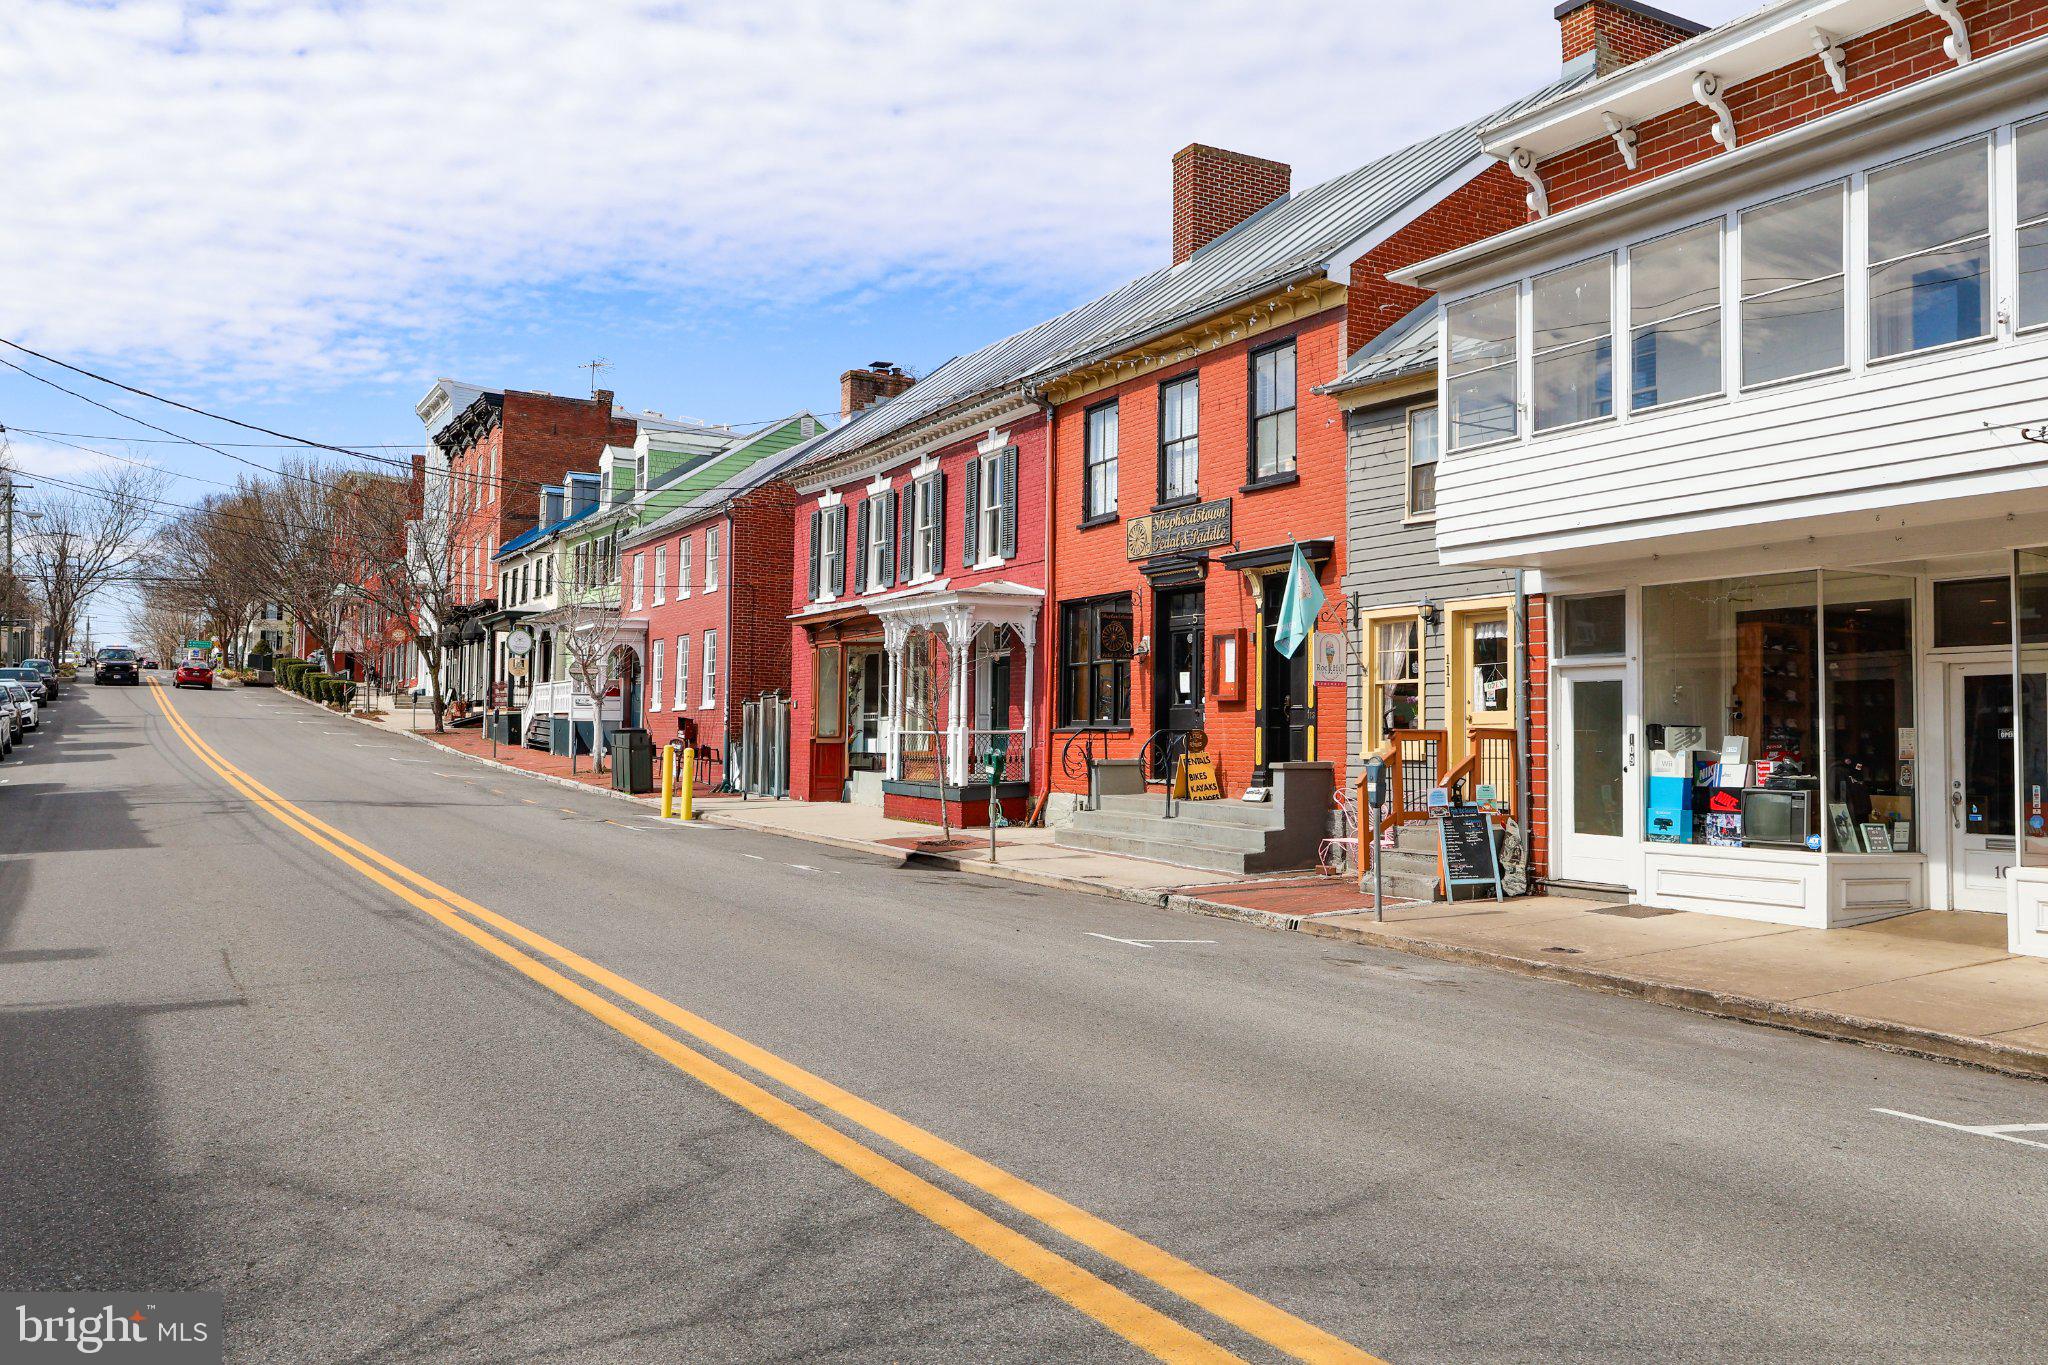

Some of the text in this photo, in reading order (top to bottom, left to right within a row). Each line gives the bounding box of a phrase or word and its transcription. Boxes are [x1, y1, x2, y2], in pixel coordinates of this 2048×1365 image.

[1153, 507, 1226, 532] Shepherdstown
[1153, 524, 1226, 551] Pedal & Paddle
[1487, 681, 1504, 690] OPEN
[1189, 772, 1208, 781] BIKES
[1190, 783, 1218, 792] KAYAKS
[1714, 790, 1739, 808] NIKE
